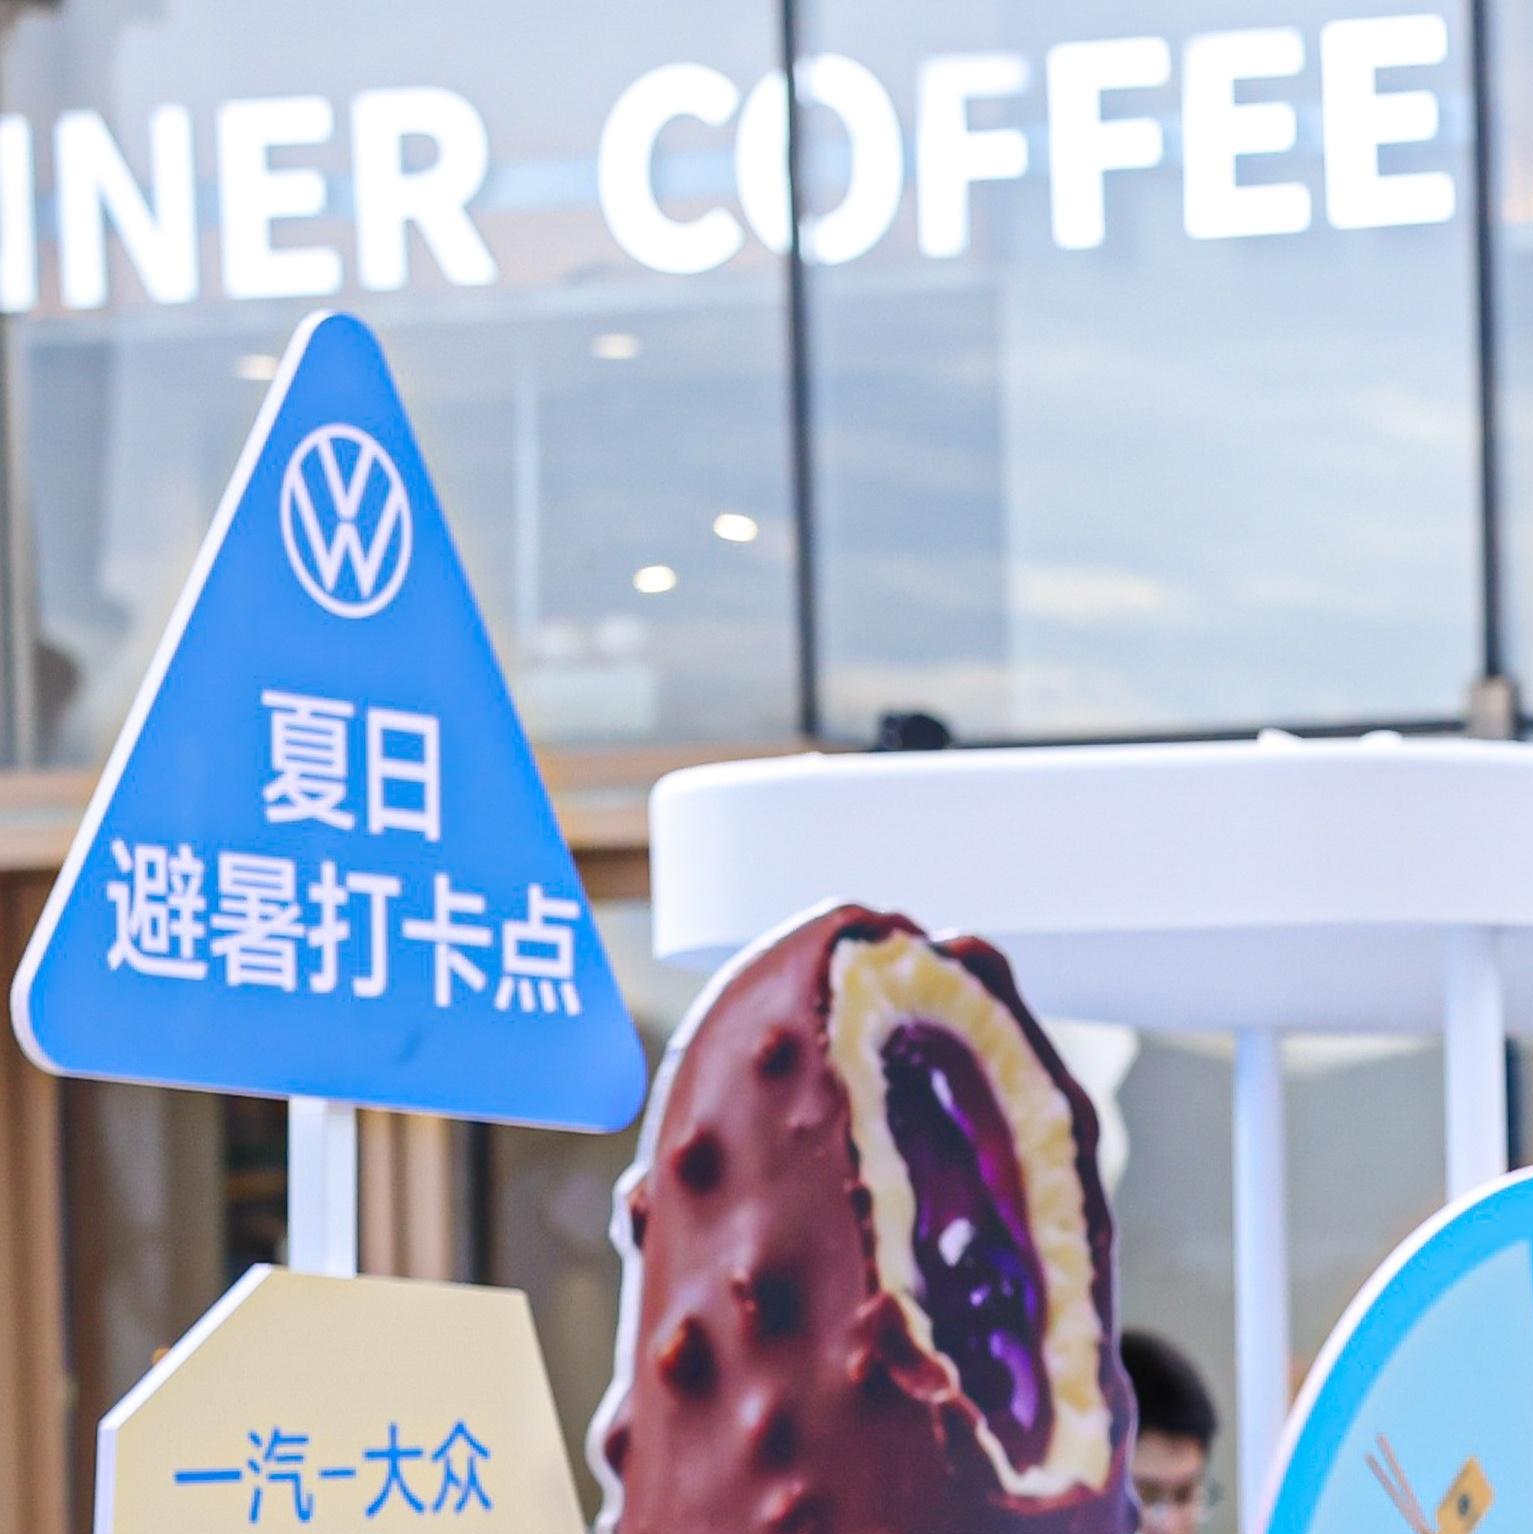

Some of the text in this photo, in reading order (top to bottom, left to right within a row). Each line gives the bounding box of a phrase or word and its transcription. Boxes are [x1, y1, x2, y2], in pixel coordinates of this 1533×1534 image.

[599, 14, 1456, 274] COFFEE
[261, 689, 440, 842] 夏日
[106, 838, 582, 1016] 避暑打卡点
